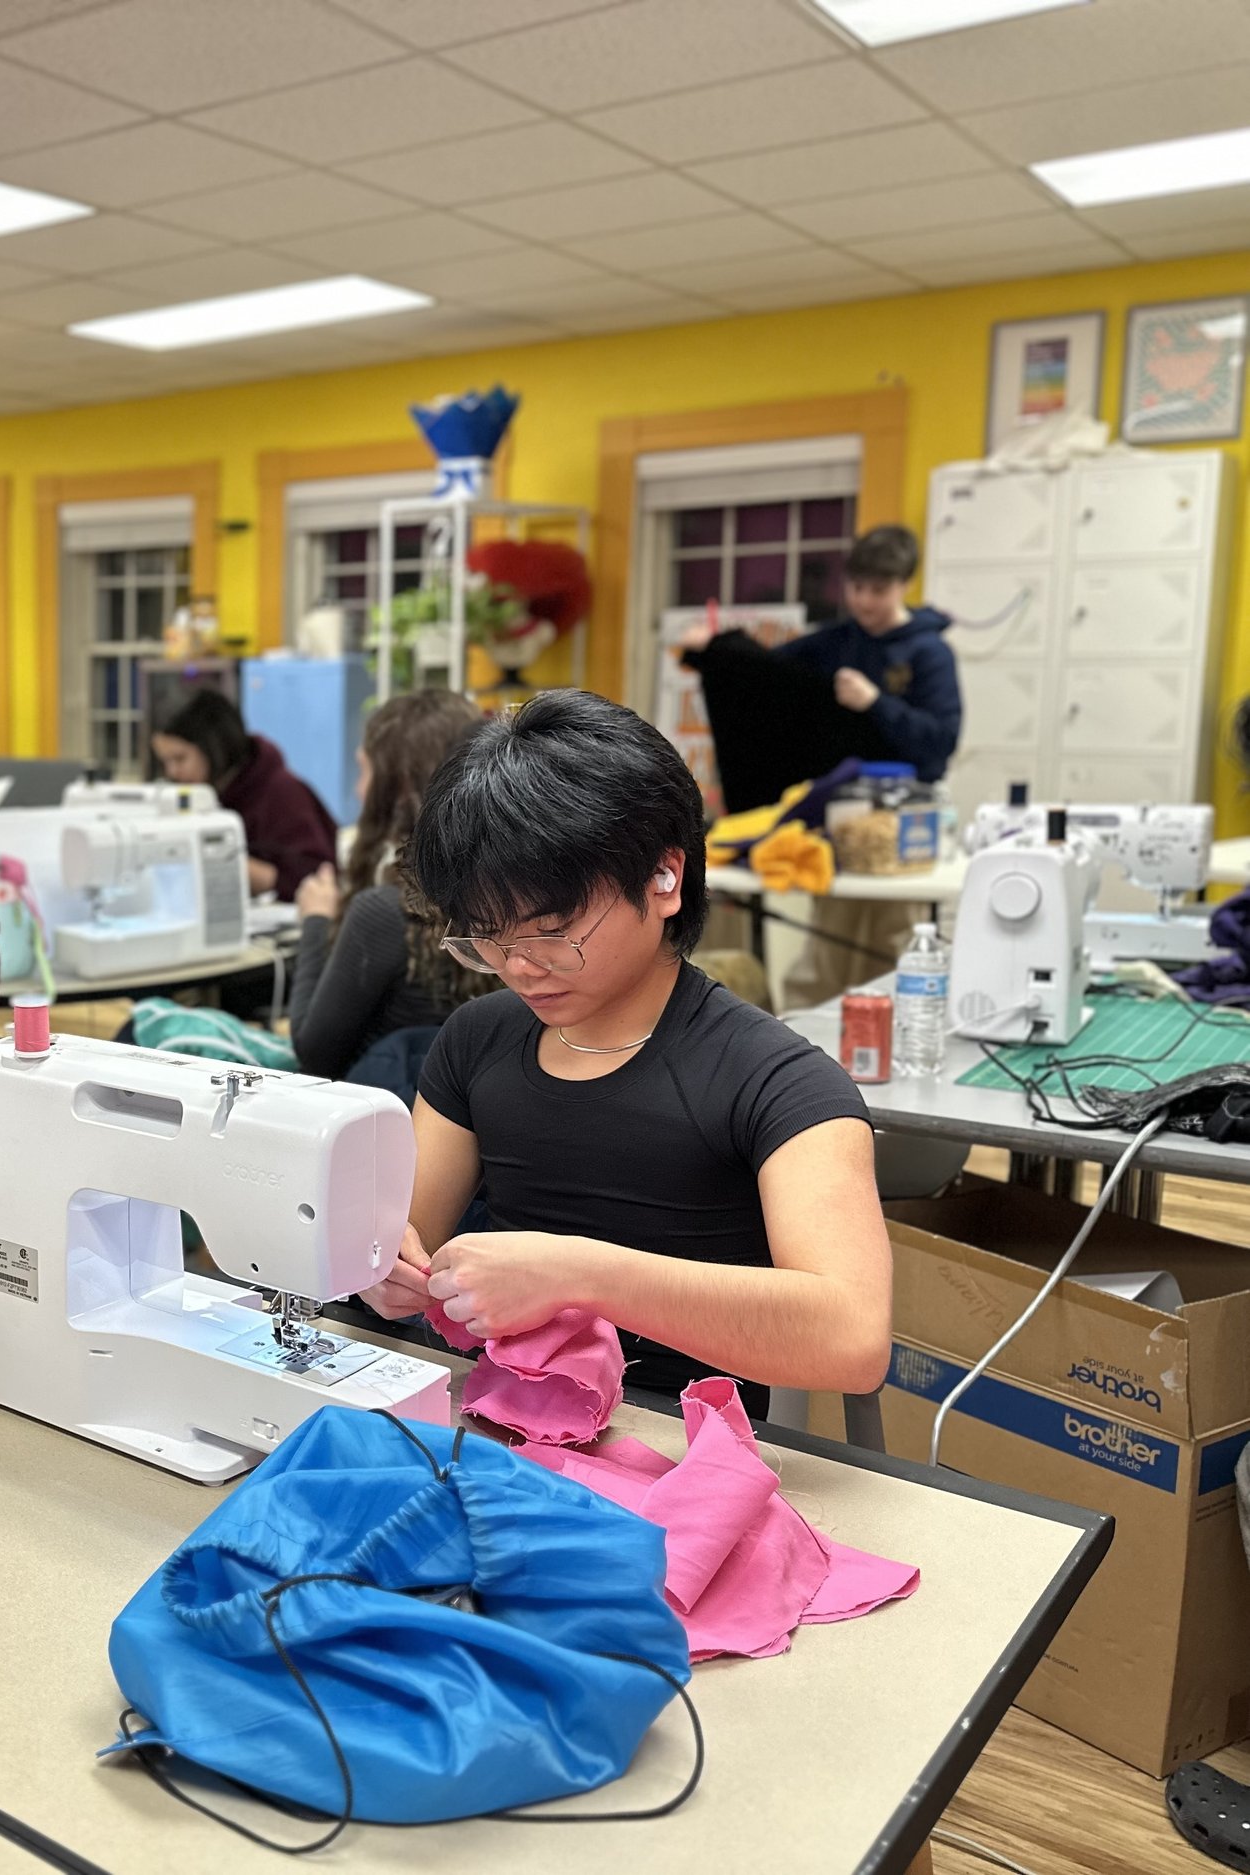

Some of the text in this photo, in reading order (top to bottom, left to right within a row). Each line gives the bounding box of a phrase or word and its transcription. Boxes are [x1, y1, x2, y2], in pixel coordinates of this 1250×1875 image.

[1067, 1363, 1161, 1413] brother
[1082, 1355, 1145, 1384] at your side
[1064, 1412, 1161, 1466] brother
[1078, 1442, 1142, 1472] at your side
